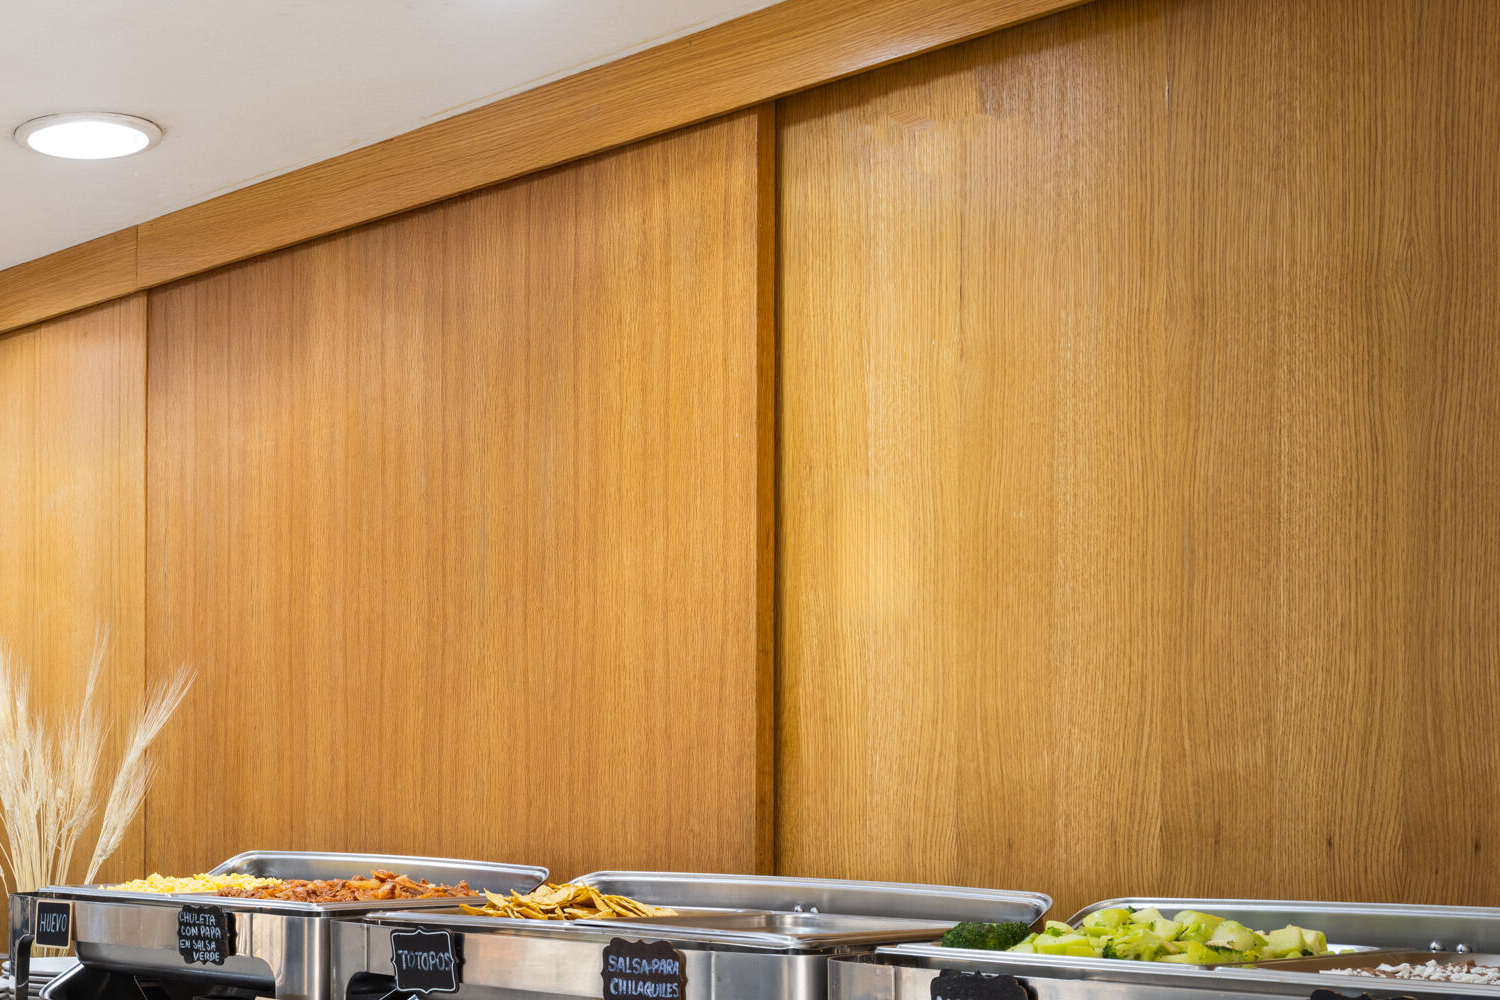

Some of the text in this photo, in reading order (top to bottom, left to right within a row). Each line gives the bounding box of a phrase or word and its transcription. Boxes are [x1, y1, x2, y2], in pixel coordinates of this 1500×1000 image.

[40, 912, 68, 932] HUEVO
[179, 911, 216, 926] CHULETA
[180, 925, 222, 939] CON PAPA
[180, 939, 217, 951] EN SALSA
[193, 951, 220, 962] VERDE
[398, 950, 451, 971] TOTOPOS
[609, 977, 679, 998] CHILAQUILES
